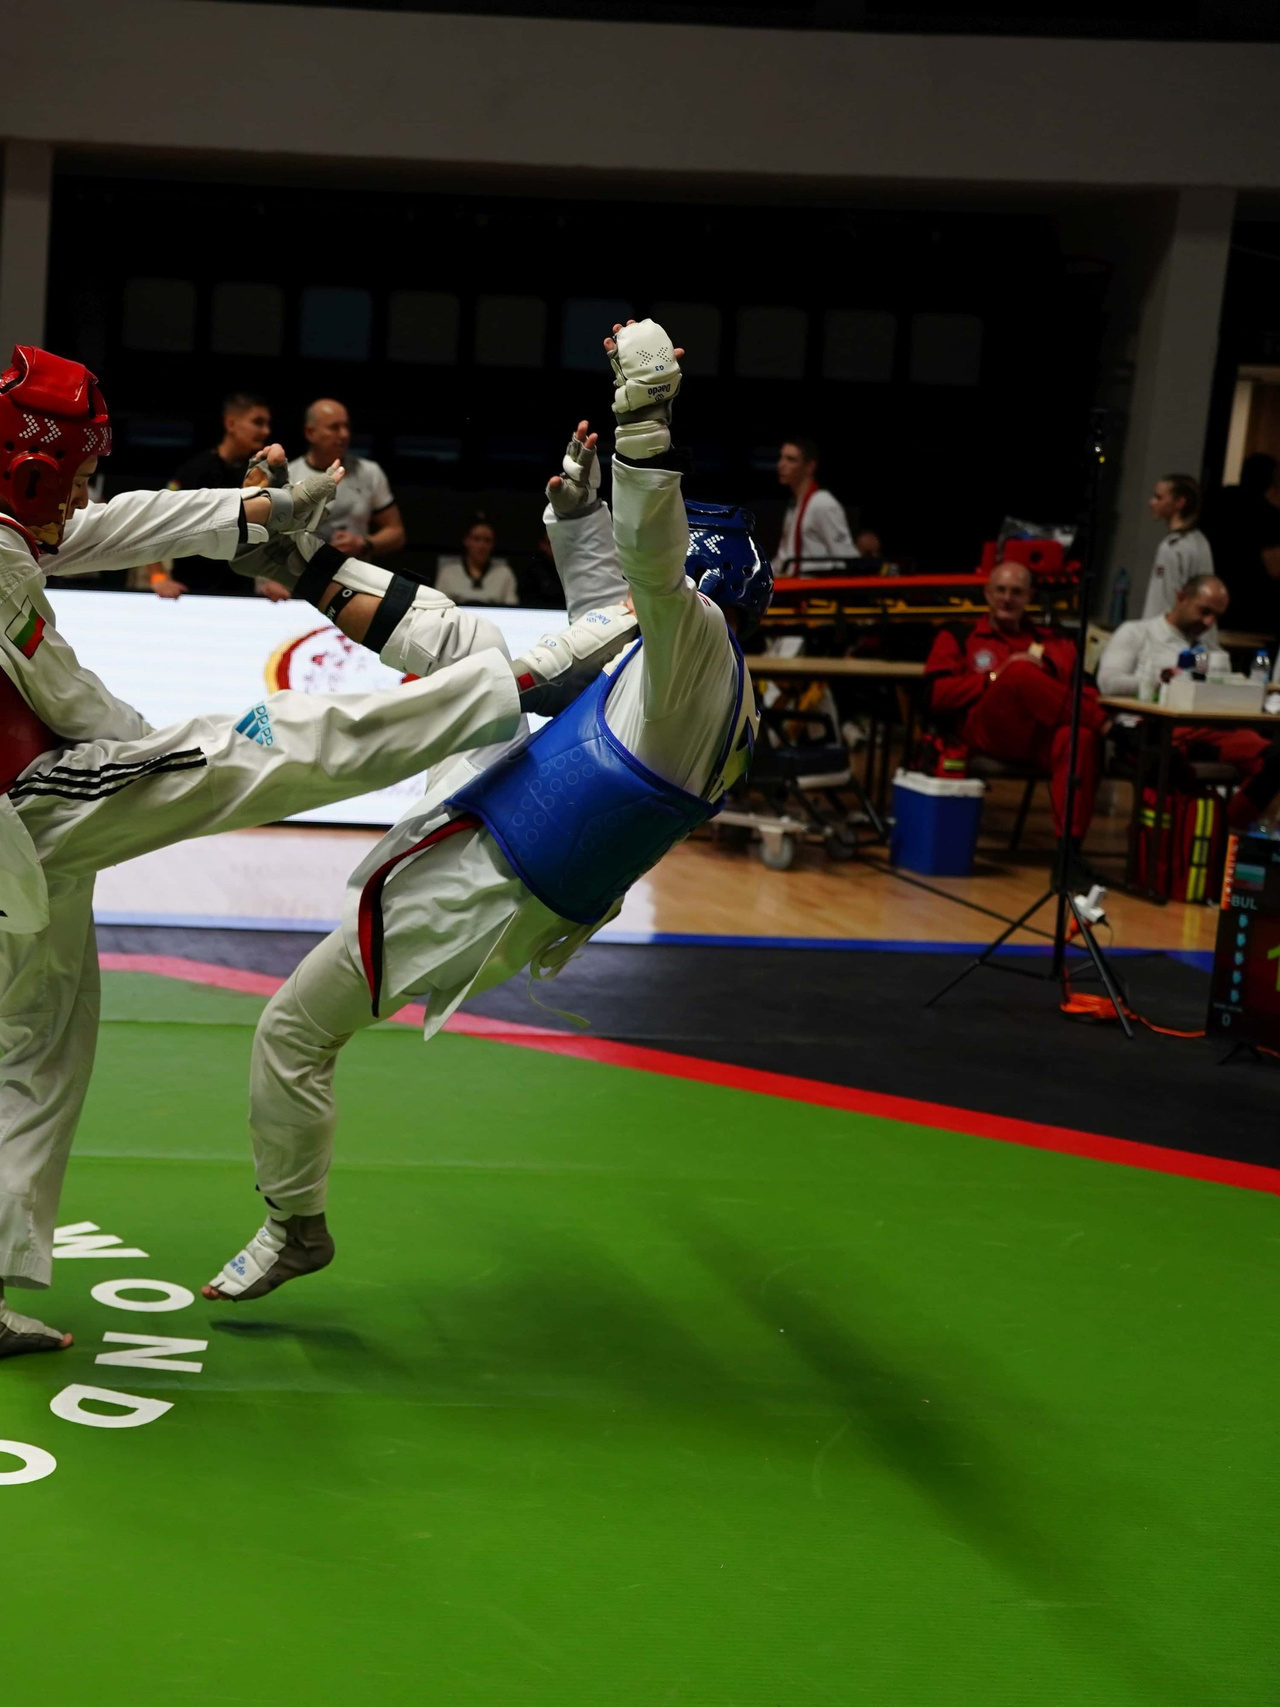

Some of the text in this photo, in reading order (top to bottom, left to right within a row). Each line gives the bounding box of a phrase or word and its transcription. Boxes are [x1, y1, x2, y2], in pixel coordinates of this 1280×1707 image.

[648, 384, 671, 395] Daedo
[255, 703, 274, 747] adida
[1230, 893, 1258, 911] BUL
